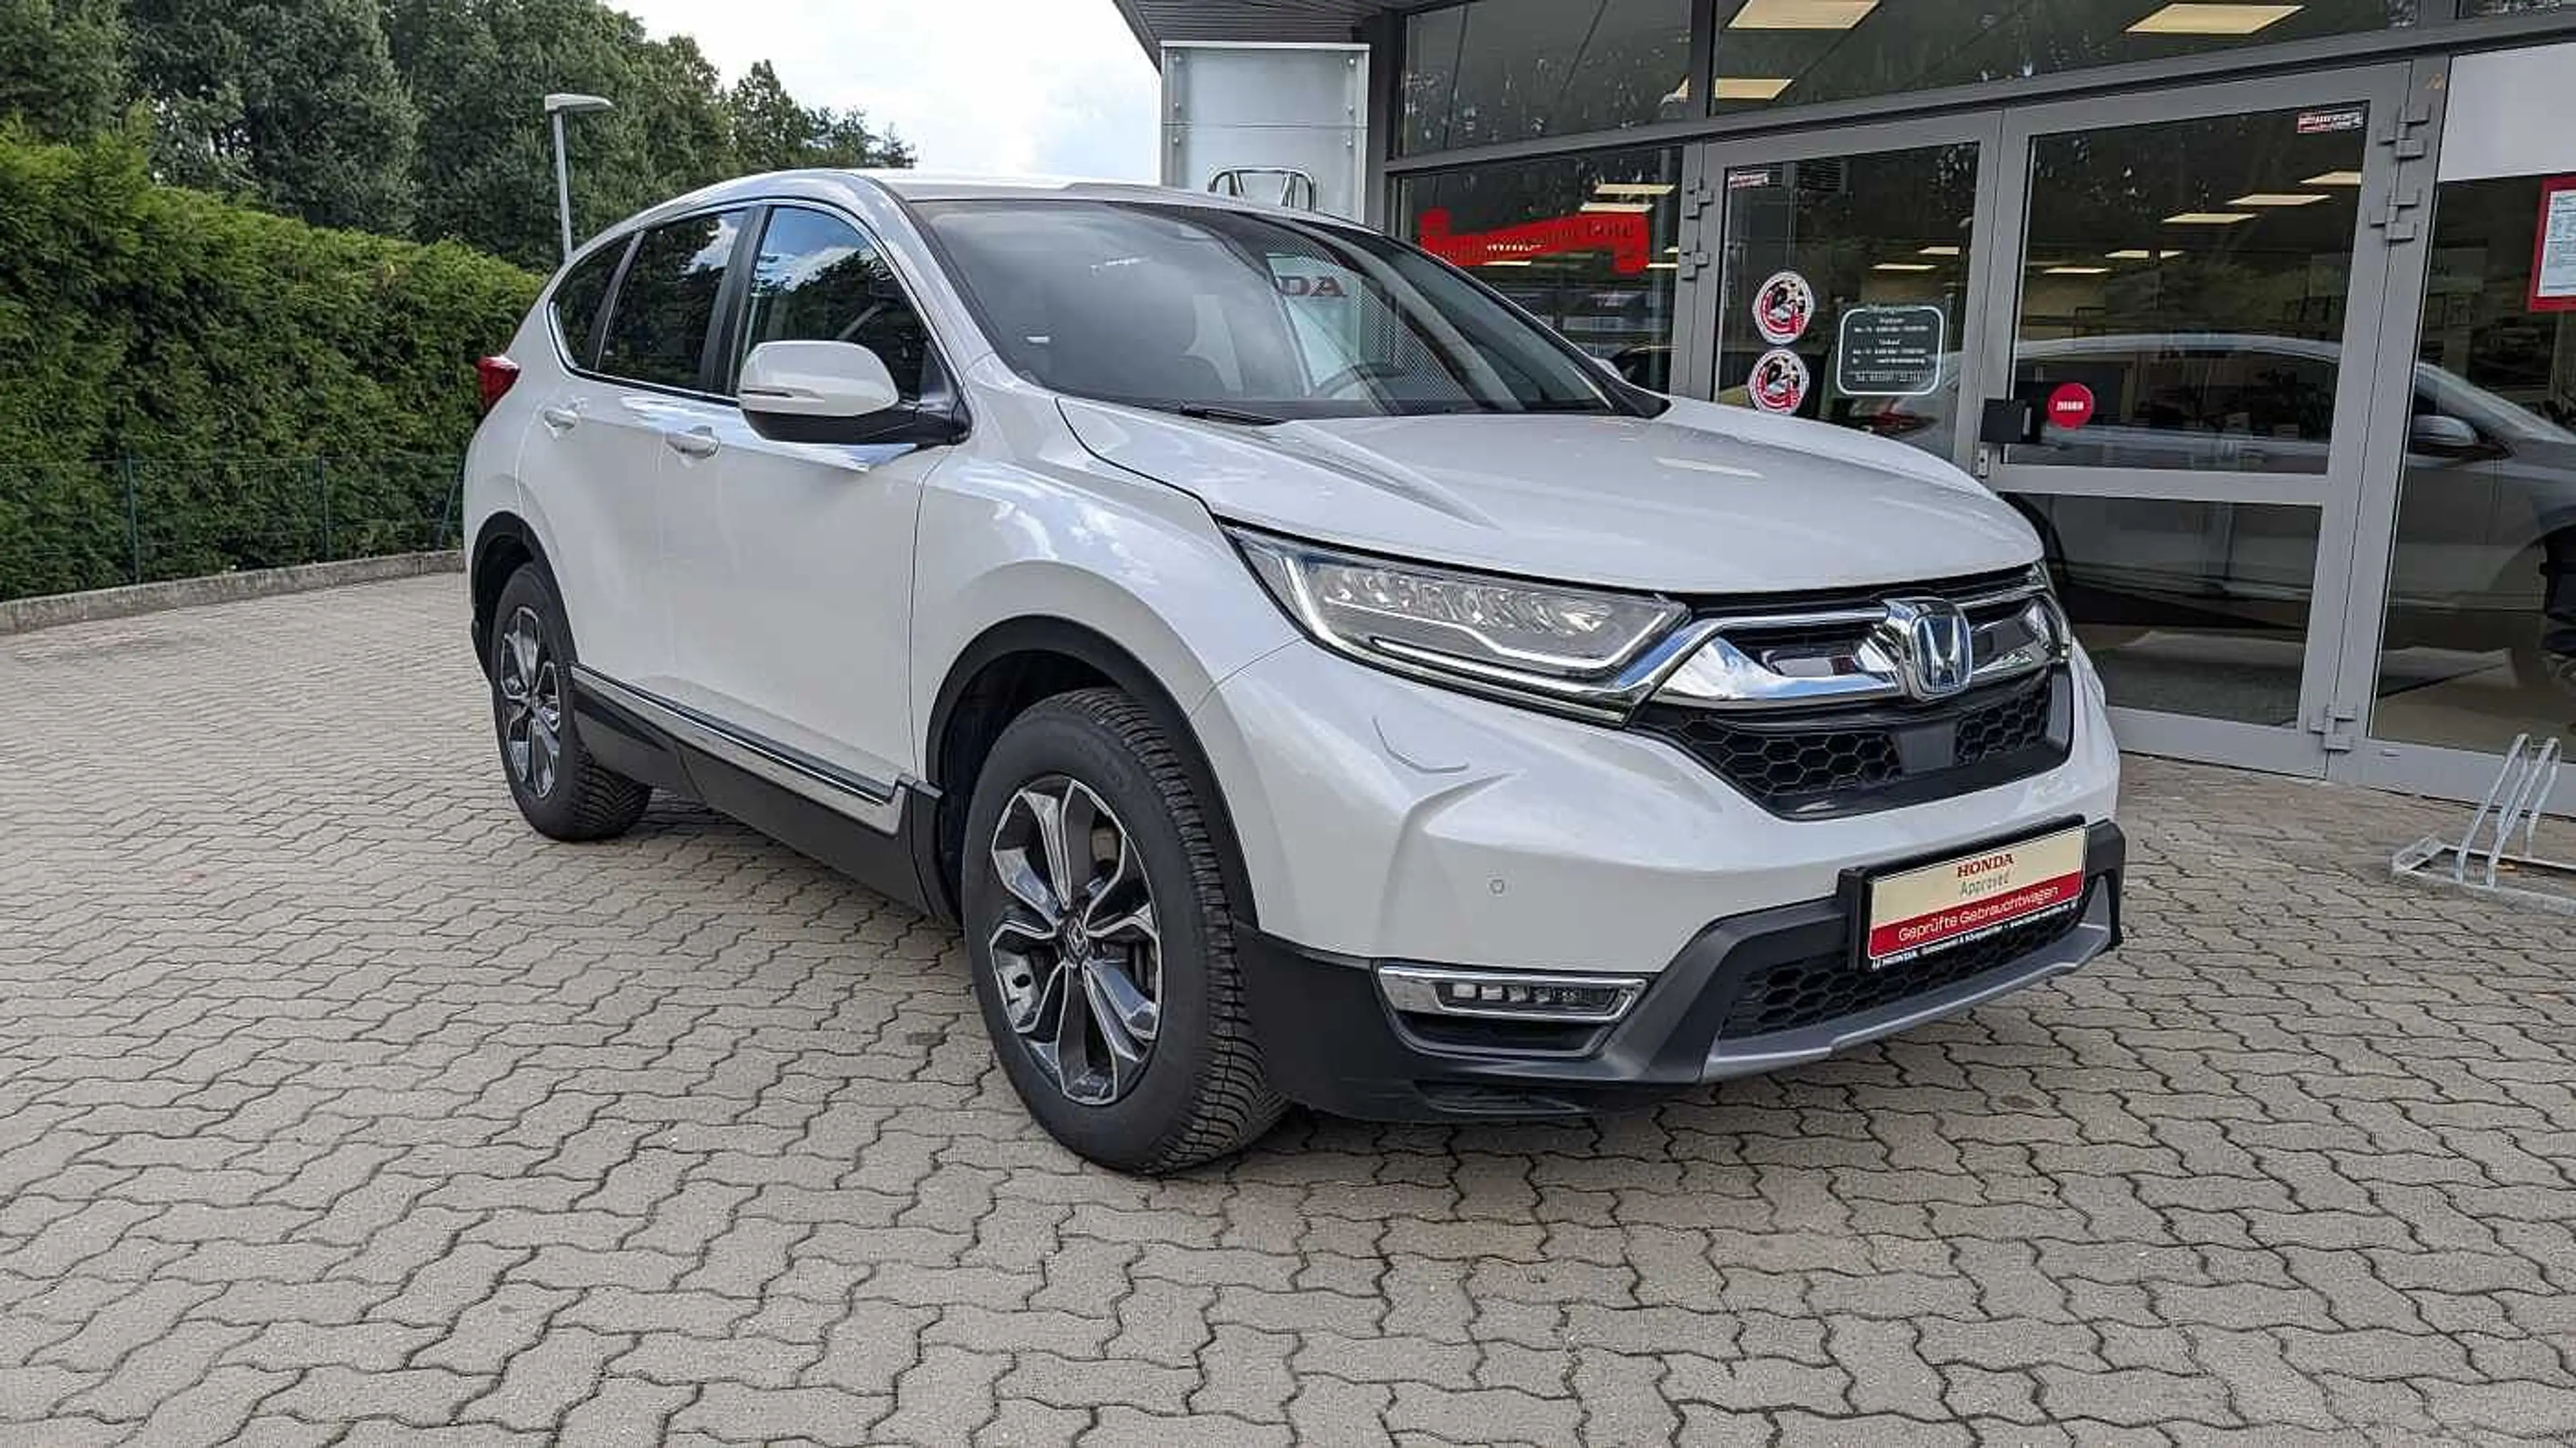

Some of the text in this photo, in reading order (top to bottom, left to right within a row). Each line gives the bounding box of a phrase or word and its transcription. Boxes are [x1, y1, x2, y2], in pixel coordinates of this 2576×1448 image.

[1957, 854, 2014, 878] HONDA
[1898, 914, 1958, 942] Geprüfte
[1960, 886, 2059, 925] Gebrauchtwagen
